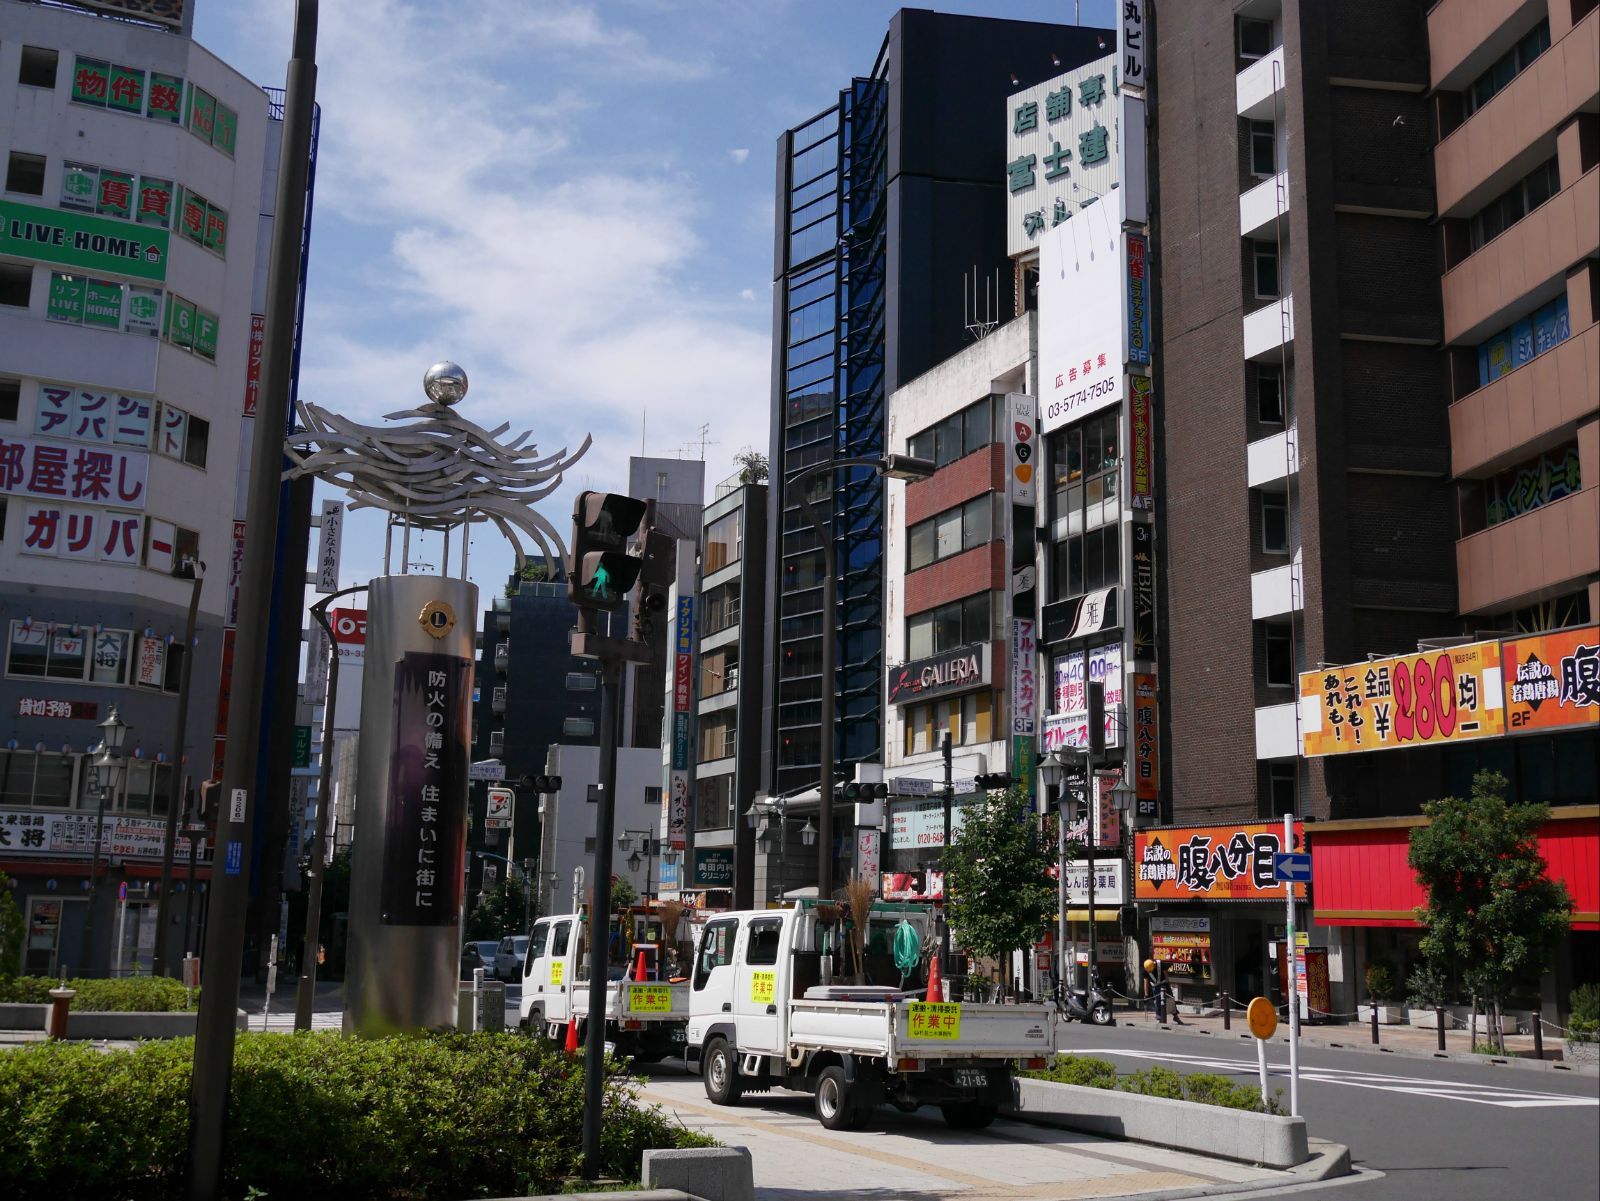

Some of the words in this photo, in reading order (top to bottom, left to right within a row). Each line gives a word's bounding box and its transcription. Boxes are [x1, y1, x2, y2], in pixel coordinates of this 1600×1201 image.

[76, 68, 181, 113] 物件数
[1013, 65, 1117, 135] 店舗専
[1008, 118, 1118, 193] 富士建
[51, 297, 80, 312] LIVE
[87, 304, 120, 318] HOME
[1130, 348, 1148, 363] 5F
[1055, 352, 1107, 389] 広告募集
[43, 388, 183, 428] マンション
[1048, 376, 1115, 419] 03-5774-7505
[41, 411, 179, 453] アパート
[1019, 427, 1027, 436] A
[1019, 448, 1027, 458] G
[1132, 496, 1153, 509] 4F
[25, 510, 172, 558] ガリバー
[1136, 526, 1150, 541] 3F
[1138, 564, 1153, 618] IBIZA
[97, 634, 121, 670] 大将
[920, 653, 979, 688] GALLERIA
[1516, 660, 1552, 681] 伝説の
[1364, 666, 1391, 700] 全品
[1511, 680, 1560, 703] 若鶏唐揚
[19, 699, 71, 719] 貸切予約
[1511, 711, 1531, 727] 2F
[423, 670, 447, 770] 防火の備え
[1015, 718, 1030, 731] 3F
[1046, 715, 1112, 752] ブルースイ
[1140, 801, 1157, 814] 2F
[415, 784, 441, 908] 住まいに街に
[1143, 845, 1171, 862] 伝説の
[700, 871, 731, 880] クリニック
[1172, 963, 1191, 972] IBIZA
[753, 981, 773, 995] 作業中
[633, 994, 668, 1005] 作業中
[912, 1013, 956, 1030] 作業中
[961, 1075, 987, 1087] 21-85
